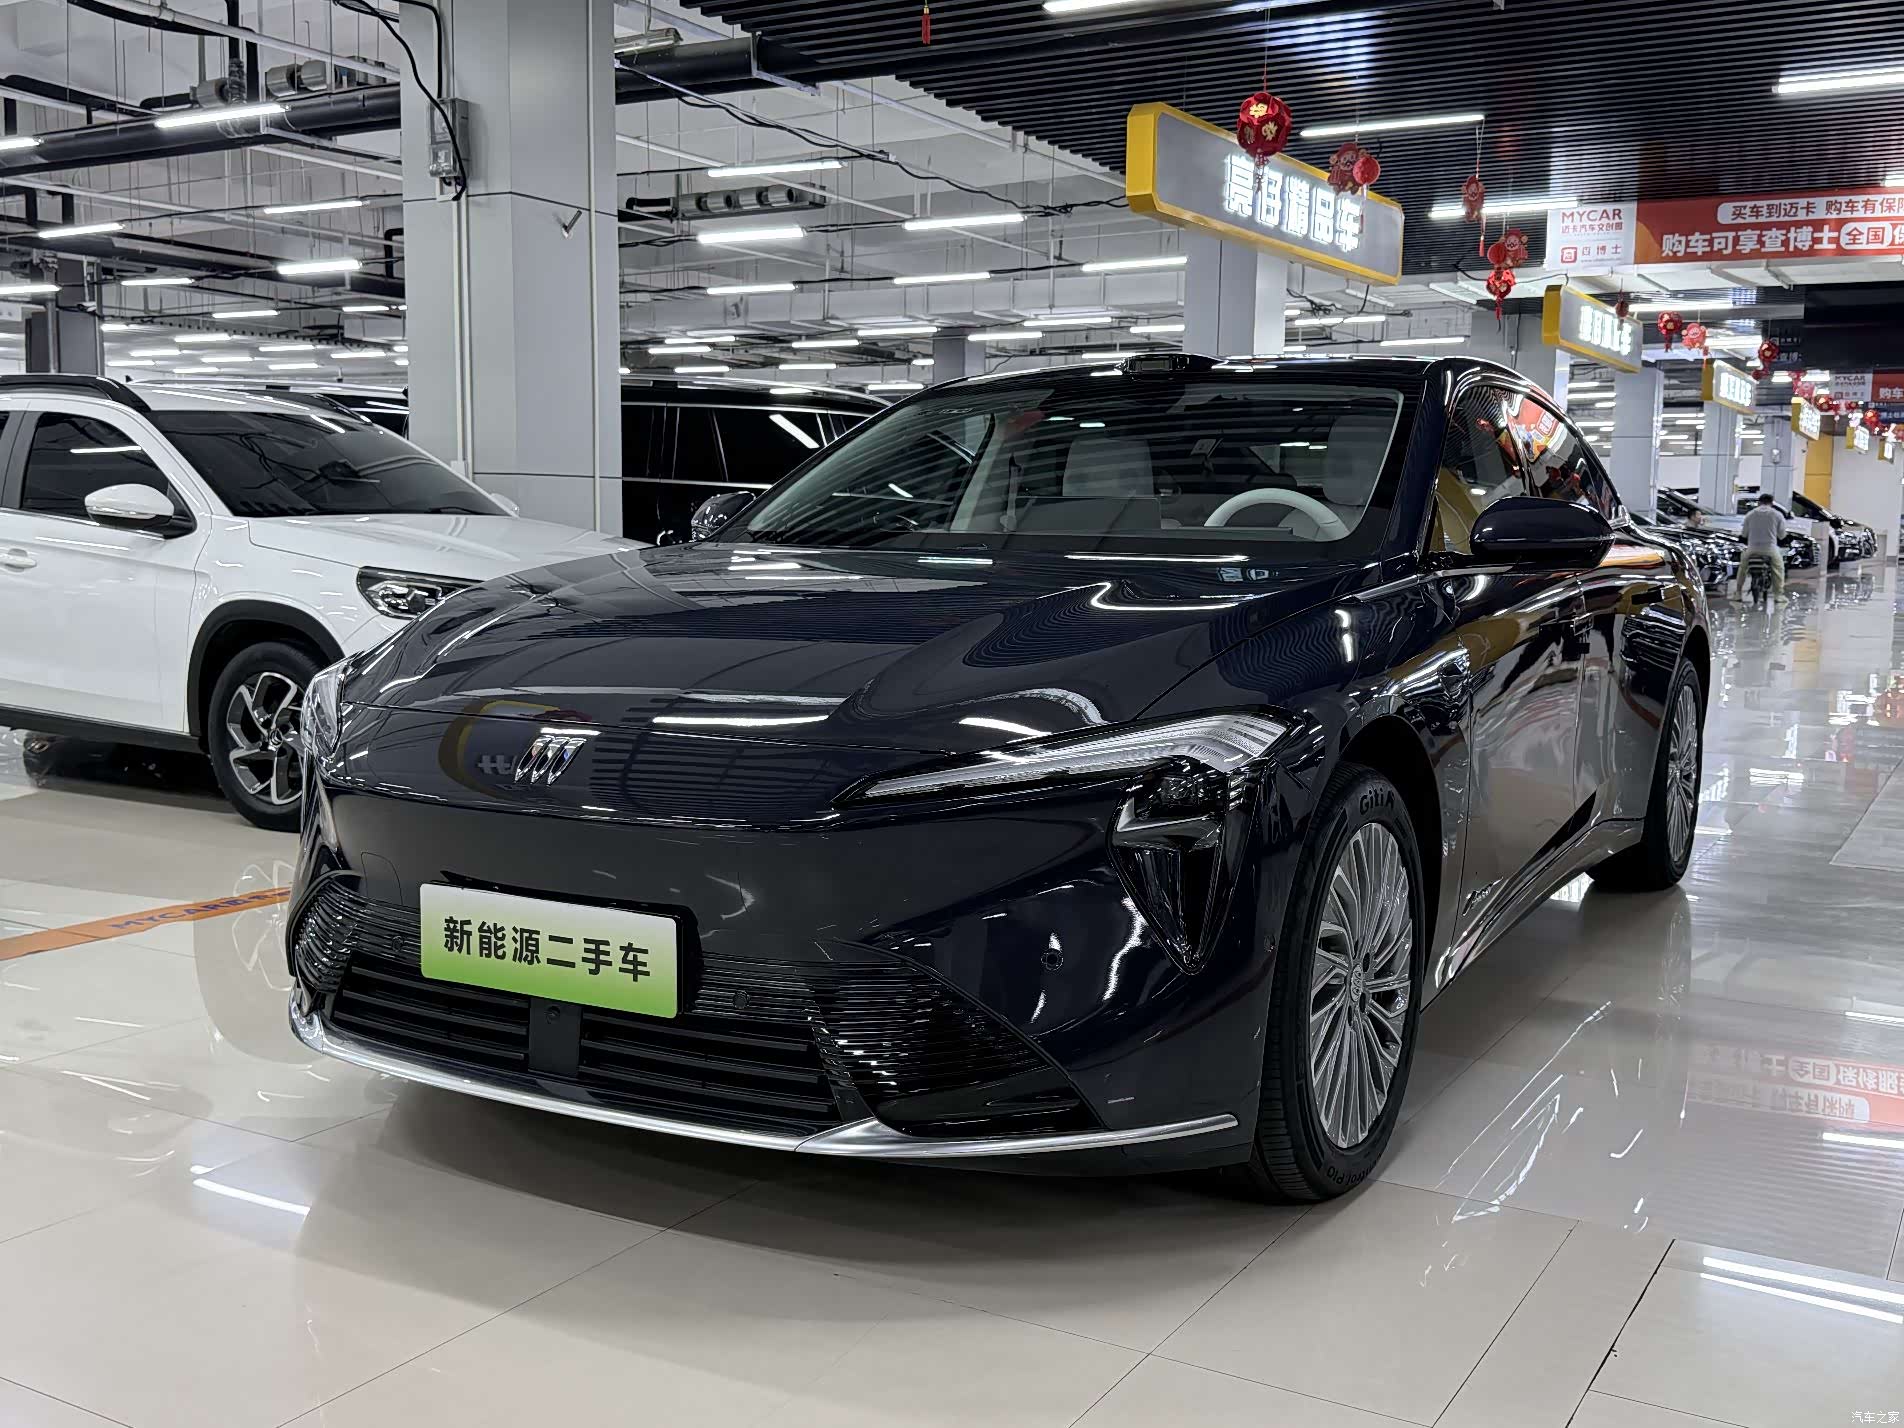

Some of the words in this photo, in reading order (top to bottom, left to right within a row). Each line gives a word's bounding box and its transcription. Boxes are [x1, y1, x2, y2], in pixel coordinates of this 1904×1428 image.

[1561, 208, 1623, 224] MYCAR
[1731, 200, 1816, 220] 买车到迈卡
[443, 915, 651, 982] 新能源二手车
